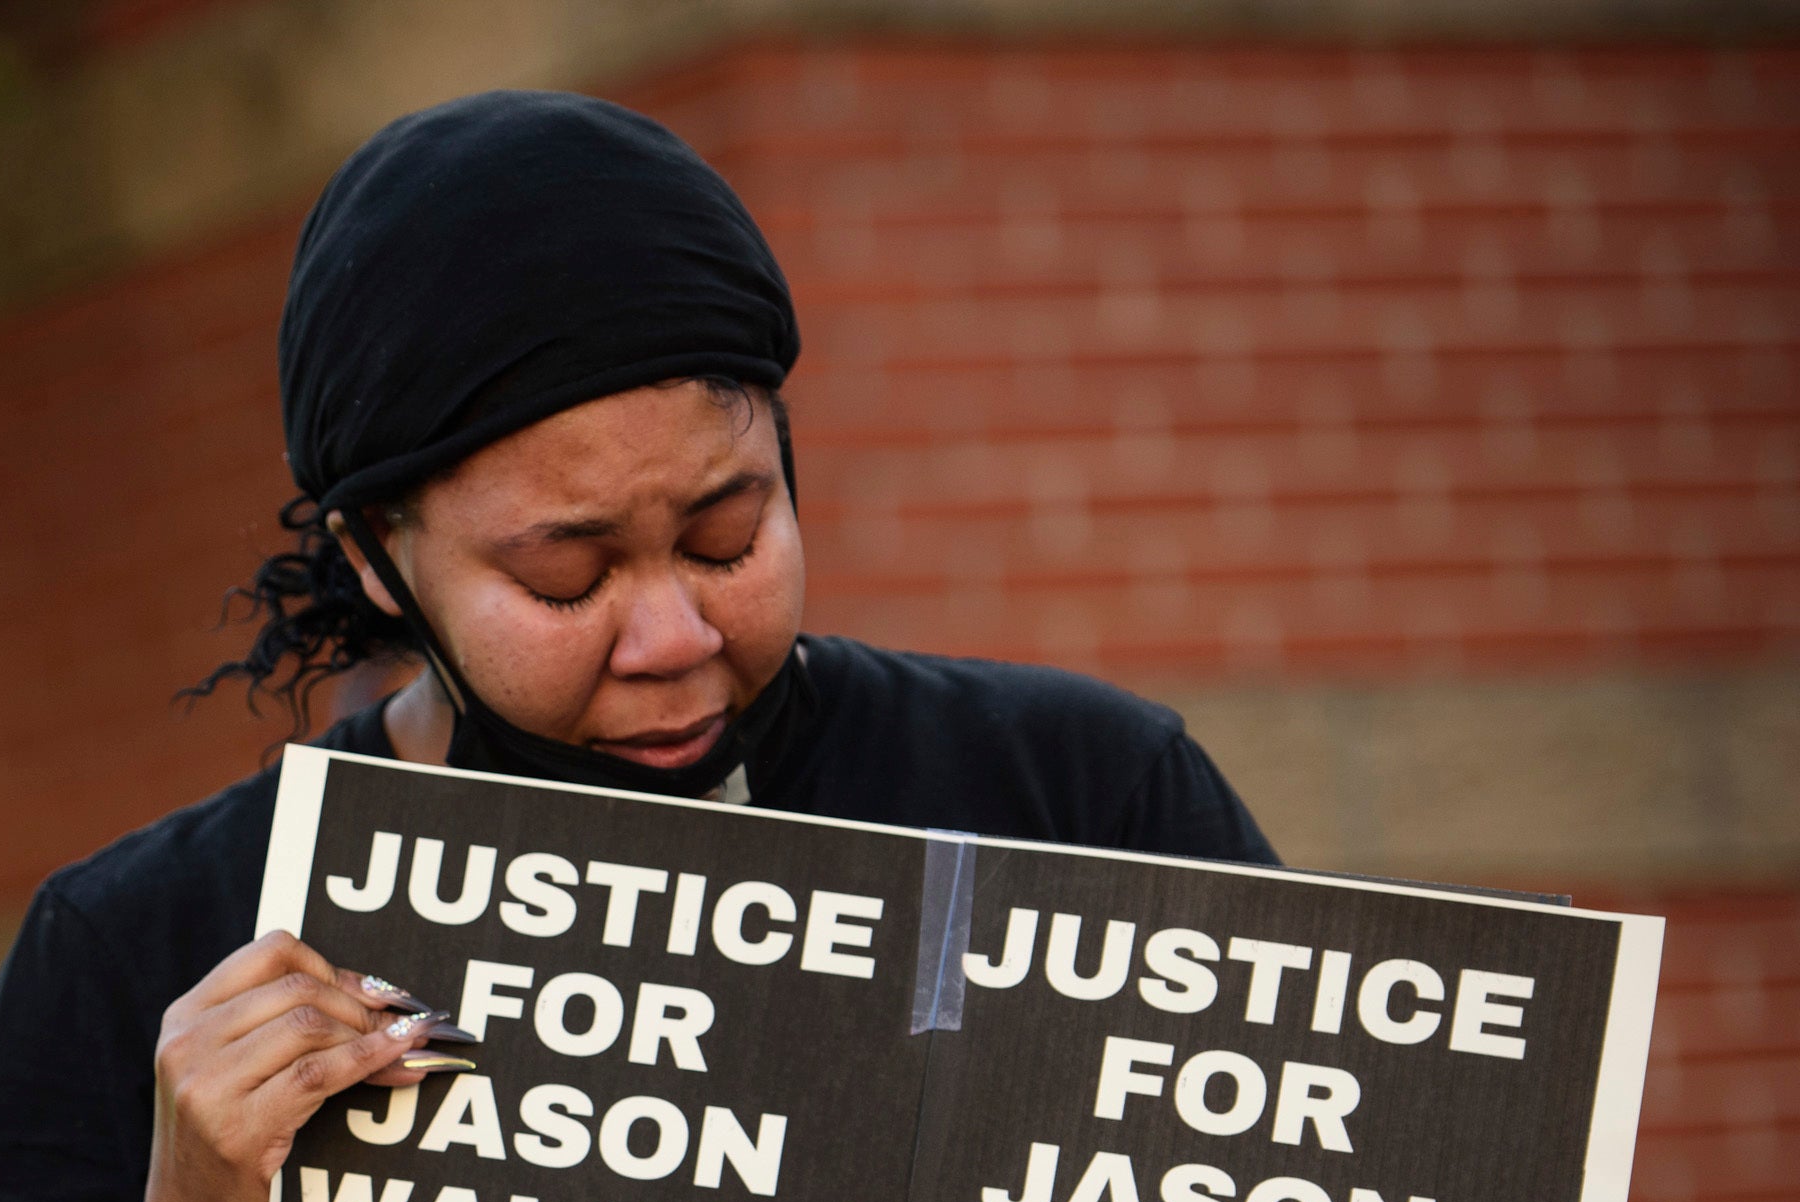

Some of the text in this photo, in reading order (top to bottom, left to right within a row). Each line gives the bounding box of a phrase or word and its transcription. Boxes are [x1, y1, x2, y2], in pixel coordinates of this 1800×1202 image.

[325, 830, 884, 979] JUSTICE
[457, 959, 715, 1073] FOR
[961, 907, 1535, 1060] JUSTICE
[346, 1073, 788, 1197] JASON
[1094, 1035, 1361, 1153] FOR
